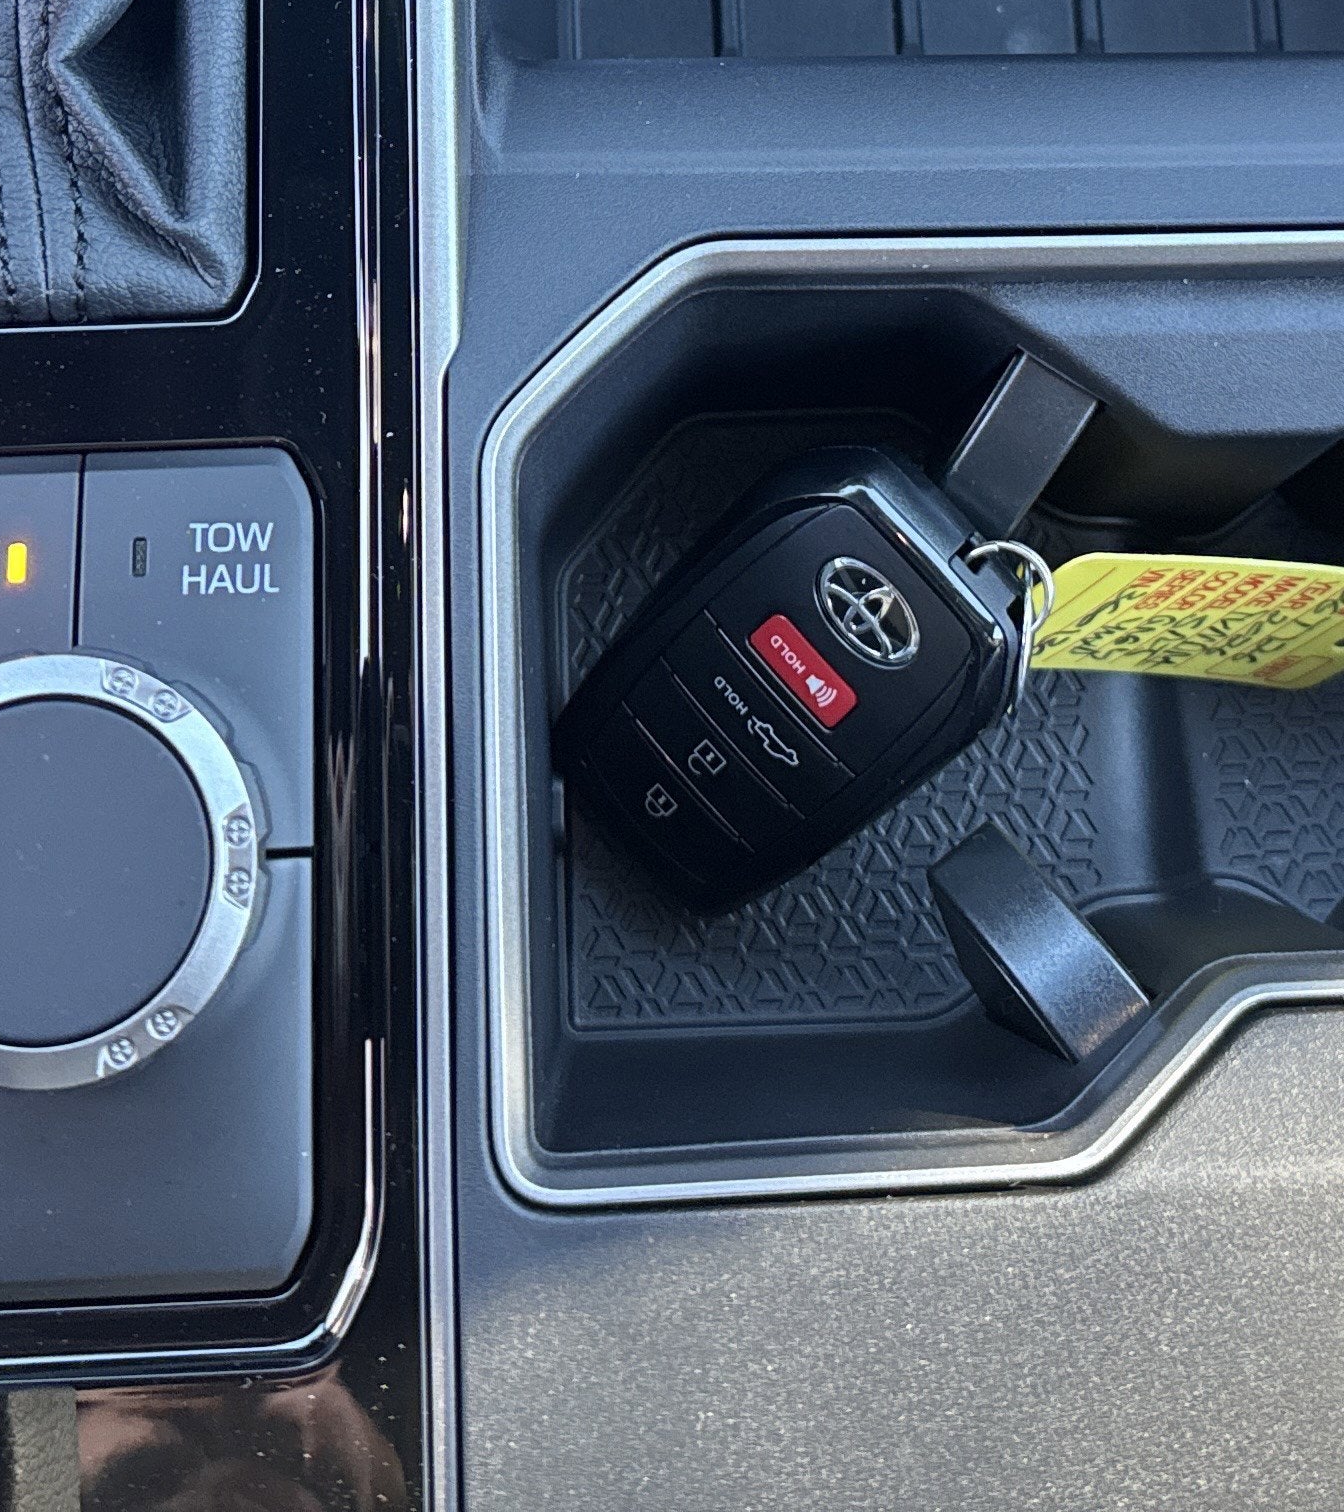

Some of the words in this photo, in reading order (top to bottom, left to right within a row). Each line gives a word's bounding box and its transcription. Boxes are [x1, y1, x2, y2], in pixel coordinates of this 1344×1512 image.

[189, 521, 274, 553] TOW
[181, 563, 280, 595] HAUL
[1131, 570, 1208, 610] SERIES
[1165, 570, 1242, 610] COLOR
[1200, 574, 1274, 610] MODEL
[1243, 576, 1308, 606] MAKE
[1278, 581, 1336, 609] YEAR
[770, 635, 806, 675] HOLD
[714, 675, 748, 716] HOLD
